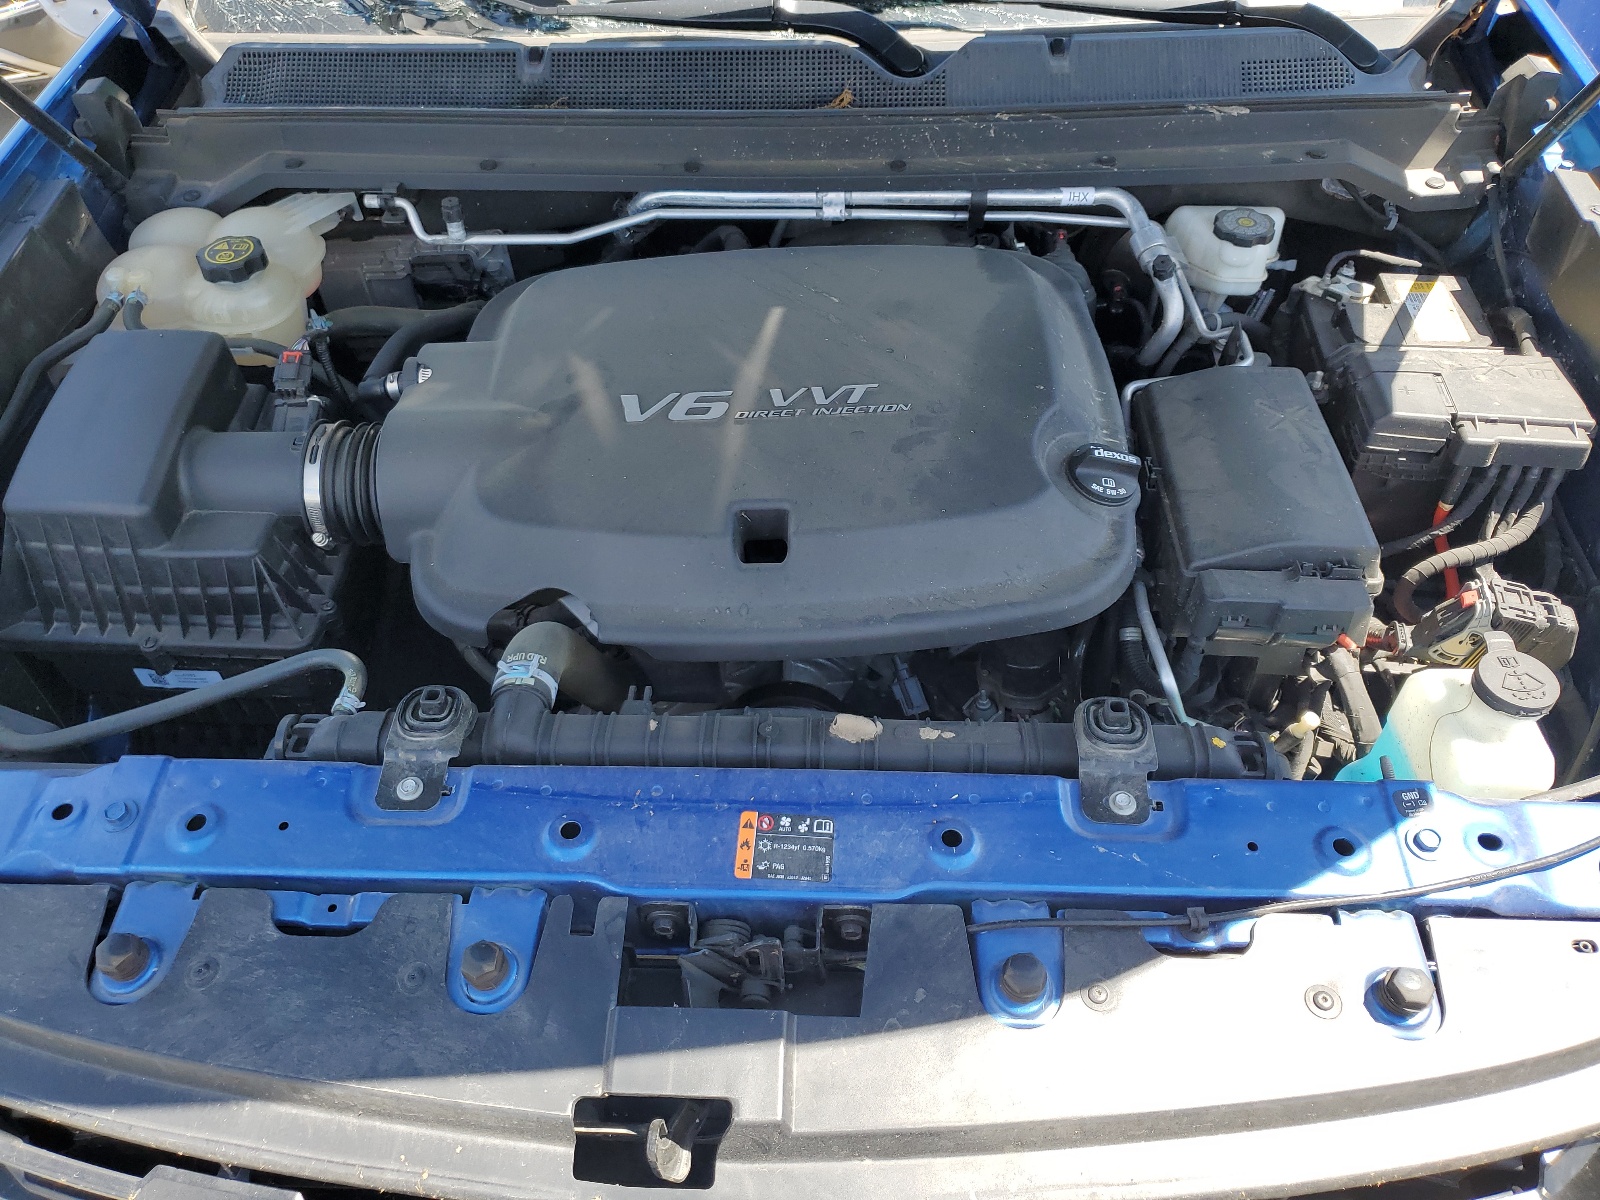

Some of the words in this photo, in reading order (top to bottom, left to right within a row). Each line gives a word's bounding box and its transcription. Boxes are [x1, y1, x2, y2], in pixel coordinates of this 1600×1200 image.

[1068, 191, 1090, 202] IHX
[620, 390, 734, 423] V6
[769, 383, 880, 408] VVT
[734, 407, 805, 419] DIRECT
[811, 403, 912, 416] INJECTION
[1094, 448, 1138, 464] dexos
[1090, 483, 1105, 493] SAE
[1106, 487, 1127, 496] 5W-30
[526, 652, 548, 665] RD
[1401, 791, 1420, 801] GND
[773, 843, 800, 851] R-1234yf
